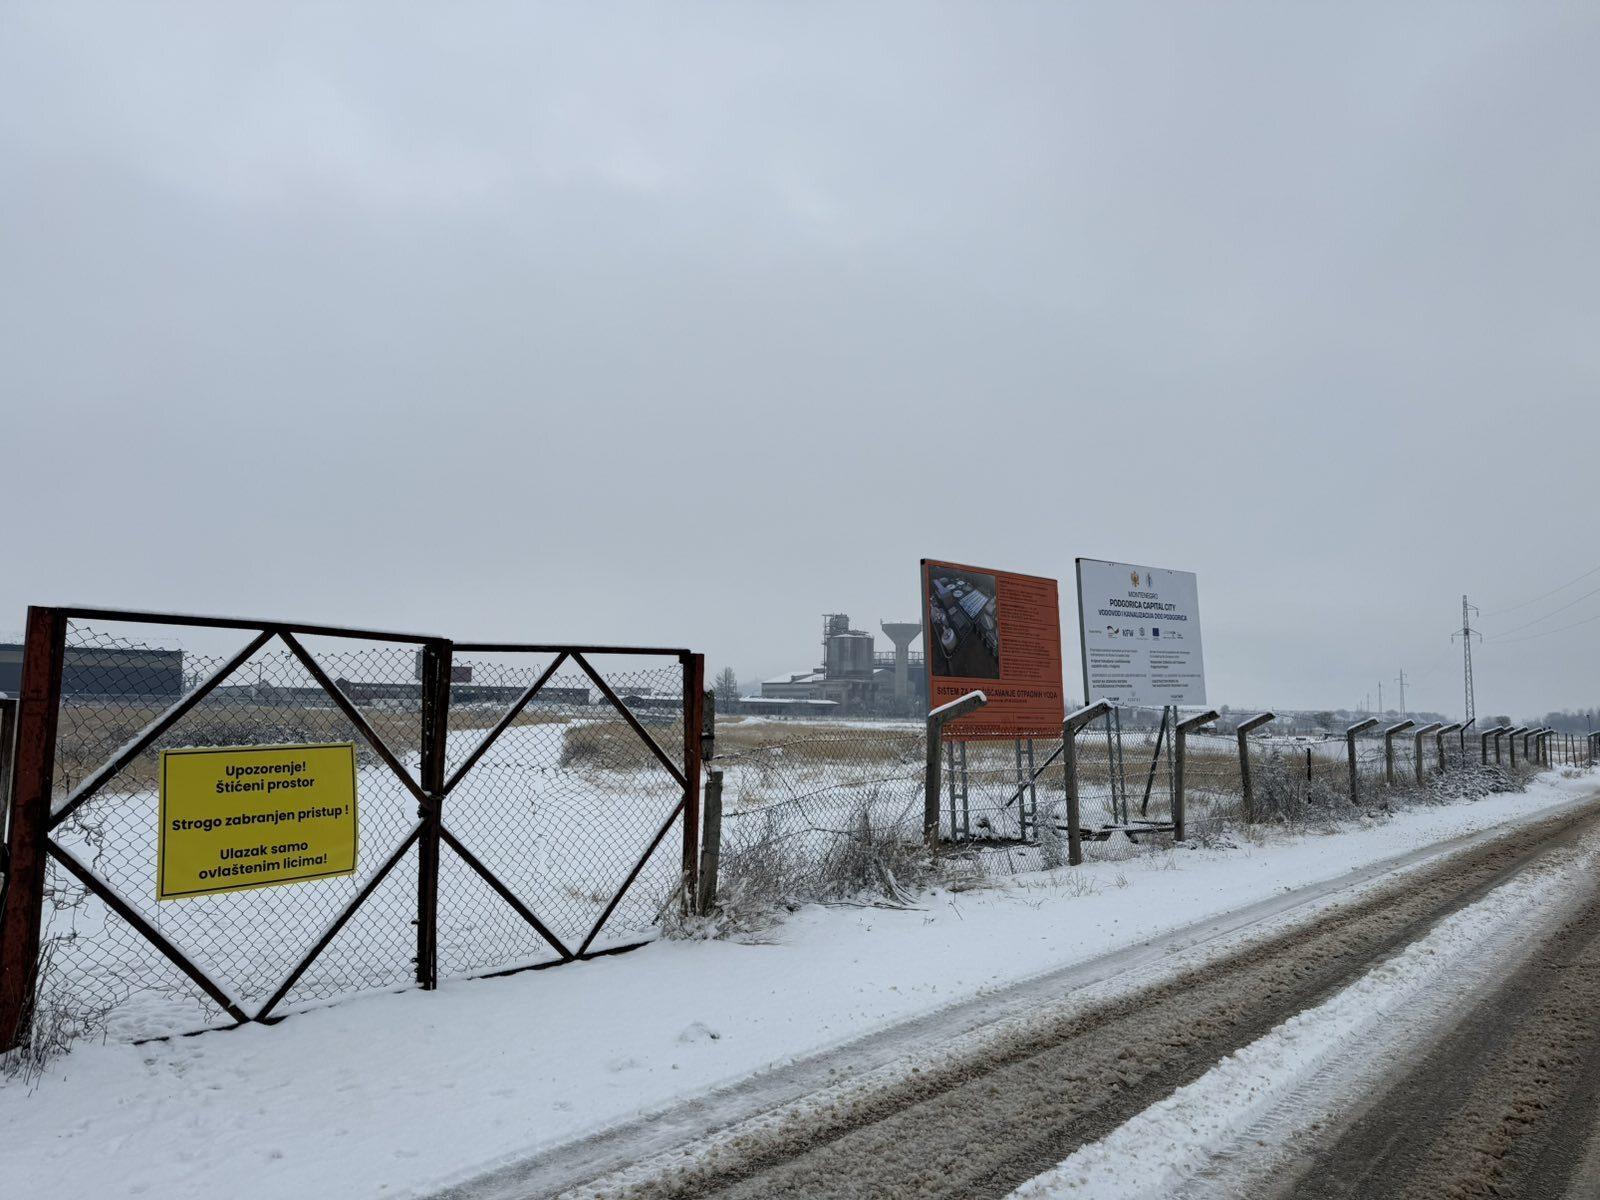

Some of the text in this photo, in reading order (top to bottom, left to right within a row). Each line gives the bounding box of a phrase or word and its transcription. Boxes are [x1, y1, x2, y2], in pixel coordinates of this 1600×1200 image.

[1128, 591, 1158, 599] MONTENEGRO
[1110, 599, 1176, 611] PODGORICA CAPITAL CITY
[937, 686, 959, 696] SISTEM
[226, 762, 306, 779] Upozorenje!
[216, 778, 314, 793] Štićeni prostor
[172, 817, 221, 831] Strogo
[226, 810, 294, 826] zabranjen
[298, 806, 342, 822] pristup
[220, 842, 308, 859] Ulazak samo
[199, 854, 327, 879] ovlaštenim licima!
